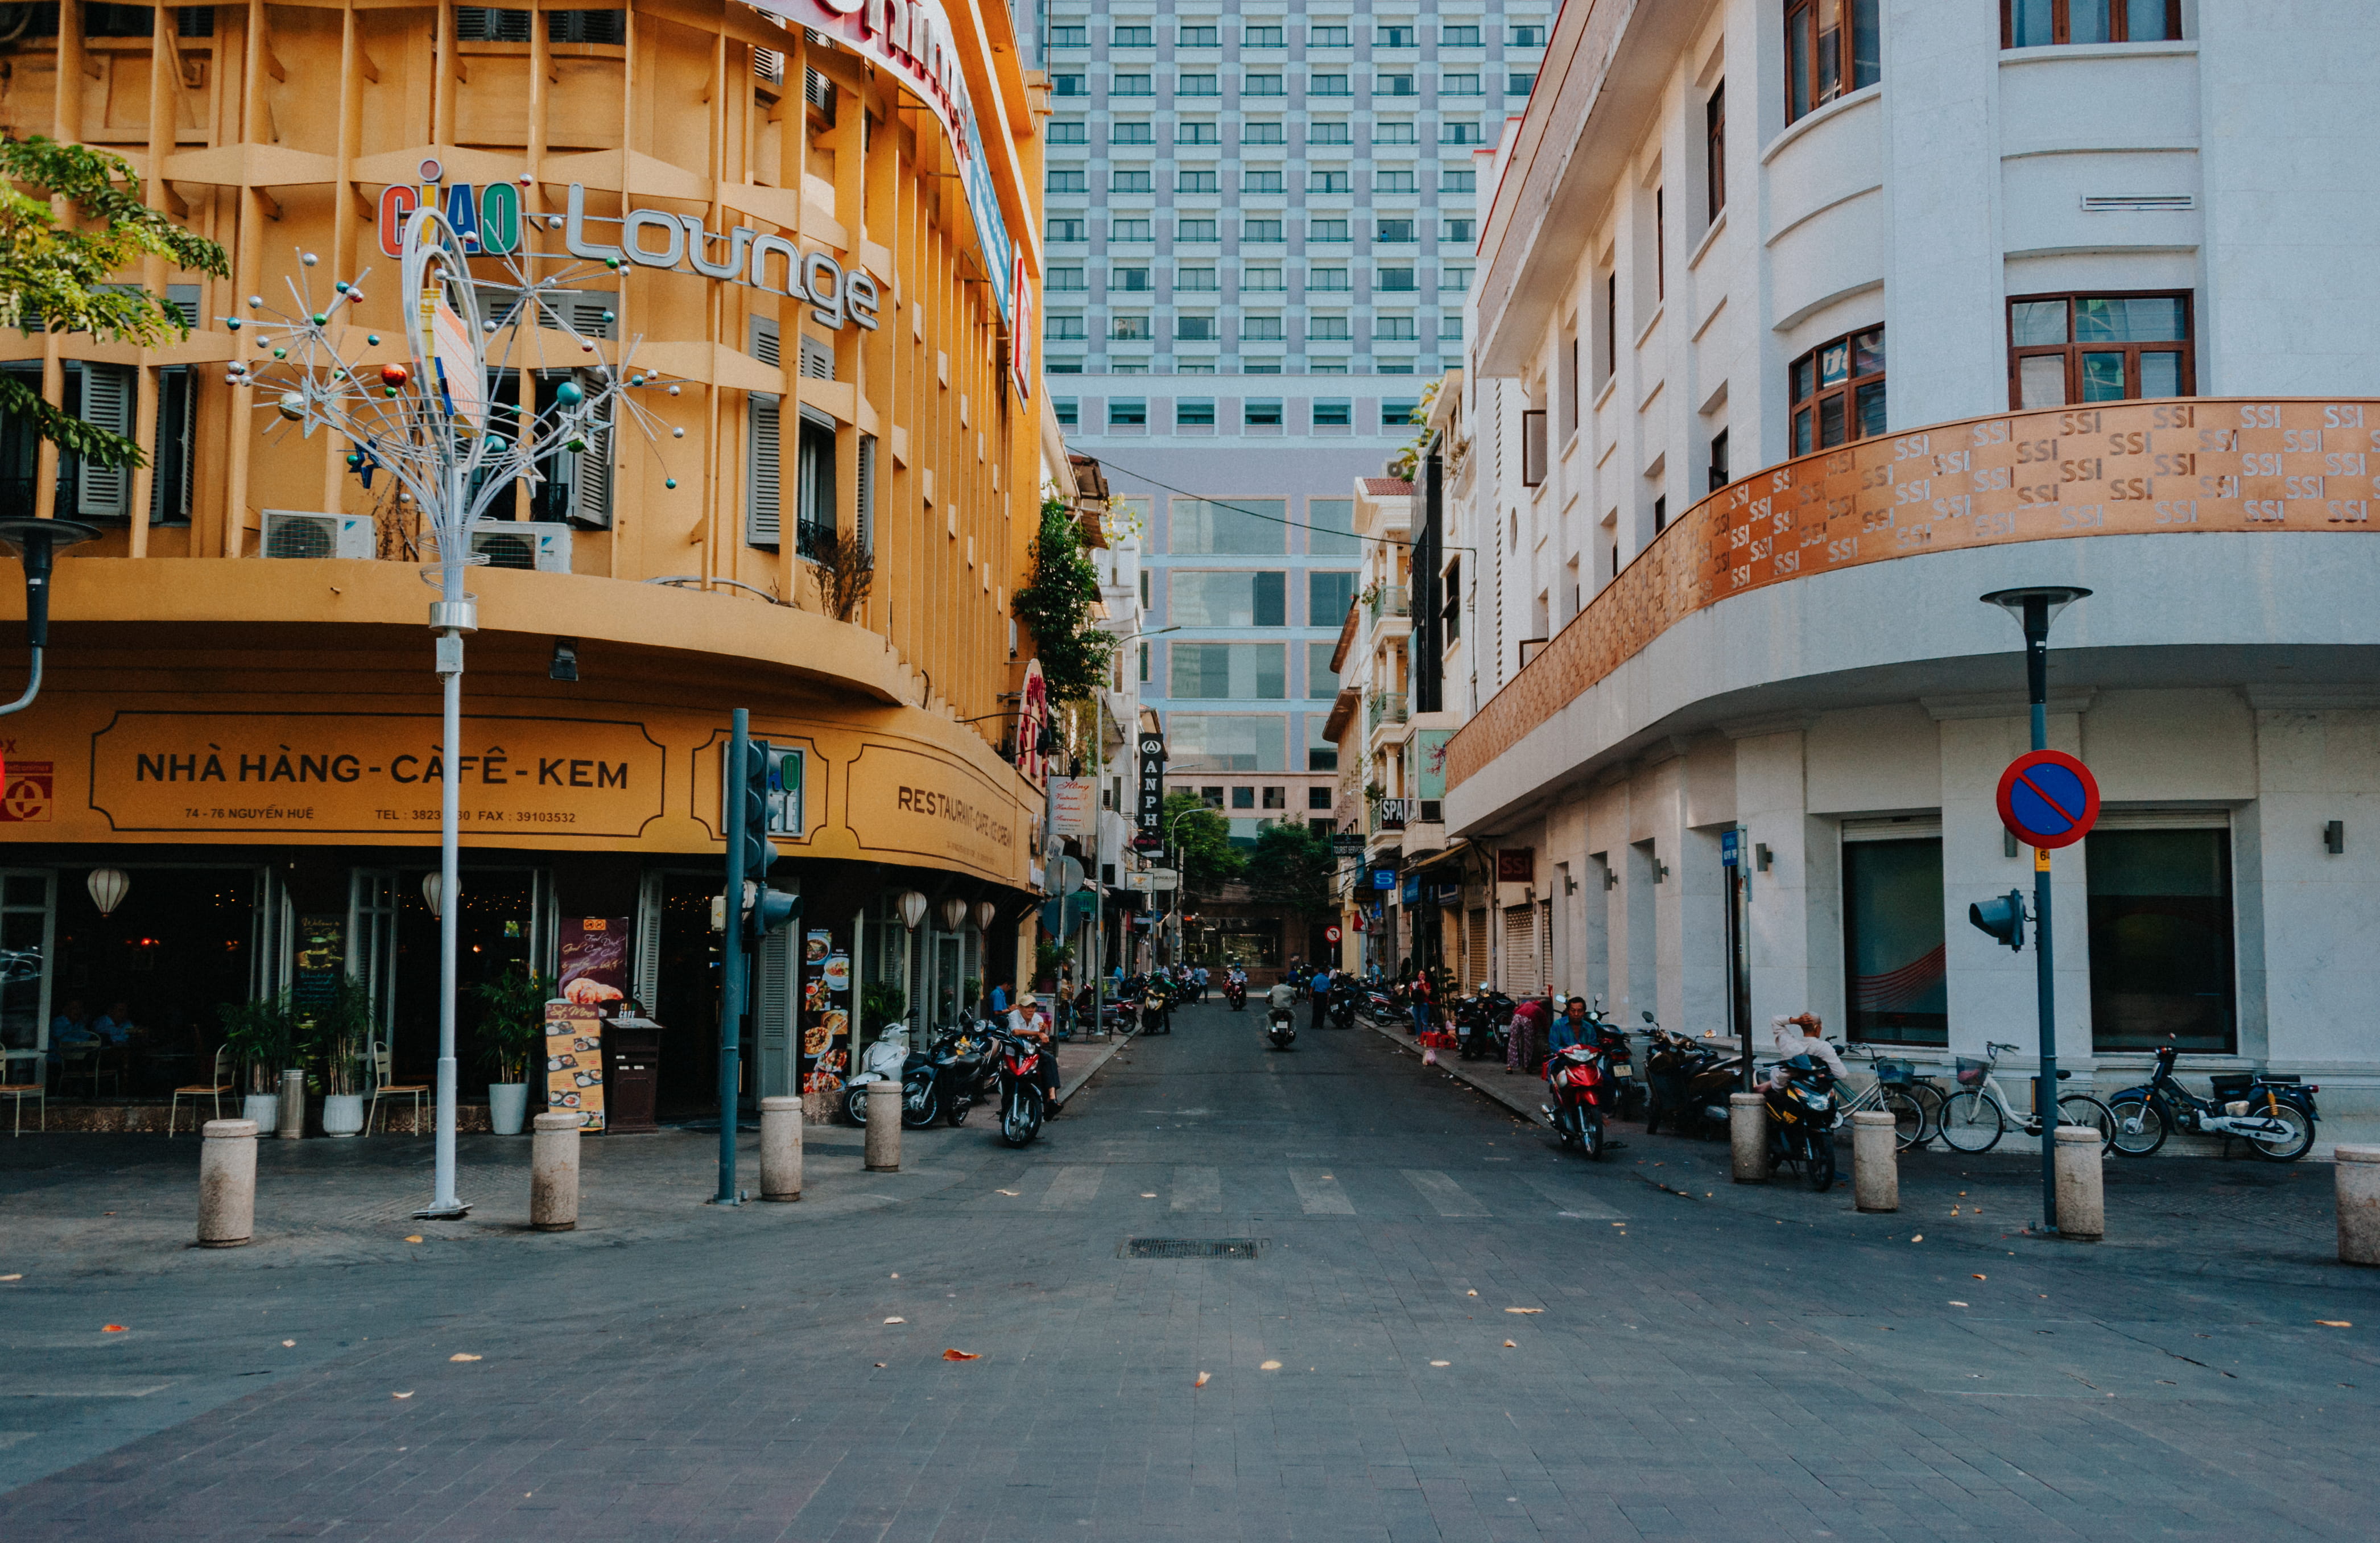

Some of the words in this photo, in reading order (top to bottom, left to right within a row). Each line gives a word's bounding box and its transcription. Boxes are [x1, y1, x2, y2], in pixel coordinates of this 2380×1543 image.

[566, 182, 879, 331] Lounge
[2059, 411, 2101, 436] SSI
[2153, 406, 2194, 430] SSI
[2241, 405, 2280, 428] SSI
[2324, 405, 2364, 428] SSI
[1973, 420, 2013, 446] SSI
[2109, 432, 2152, 456] SSI
[2199, 429, 2238, 452] SSI
[2283, 430, 2323, 453] SSI
[1894, 434, 1929, 461] SSI
[2017, 439, 2057, 464] SSI
[1827, 451, 1856, 477] SSI
[1932, 450, 1970, 477] SSI
[2059, 458, 2102, 482] SSI
[2154, 453, 2195, 477] SSI
[2242, 452, 2283, 476] SSI
[2325, 452, 2366, 476] SSI
[1773, 469, 1798, 493] SSI
[1862, 464, 1894, 490] SSI
[1974, 466, 2014, 492] SSI
[2110, 477, 2152, 502] SSI
[2199, 476, 2239, 498] SSI
[2284, 476, 2325, 500] SSI
[1730, 484, 1749, 510] SSI
[1800, 480, 1825, 505] SSI
[1895, 479, 1930, 506] SSI
[2017, 484, 2058, 510] SSI
[1749, 496, 1771, 522] SSI
[1827, 494, 1857, 519] SSI
[1932, 494, 1971, 521] SSI
[2060, 505, 2102, 529] SSI
[2155, 500, 2197, 524] SSI
[2243, 500, 2284, 522] SSI
[2327, 500, 2367, 523] SSI
[1714, 513, 1729, 536] SSI
[1773, 509, 1798, 534] SSI
[1862, 508, 1894, 533] SSI
[1976, 511, 2016, 537] SSI
[1731, 524, 1750, 550] SSI
[1800, 522, 1827, 547] SSI
[1896, 523, 1931, 550] SSI
[1750, 536, 1772, 562] SSI
[1828, 537, 1858, 562] SSI
[1714, 551, 1729, 574] SSI
[1775, 550, 1799, 575] SSI
[1731, 564, 1750, 589] SSI
[136, 743, 226, 782] NHÀ
[1144, 760, 1158, 835] ANPH
[1382, 800, 1403, 820] SPA
[211, 808, 225, 818] 76
[412, 810, 470, 820] 382330
[517, 811, 576, 822] 39103532
[1501, 857, 1530, 874] SSI
